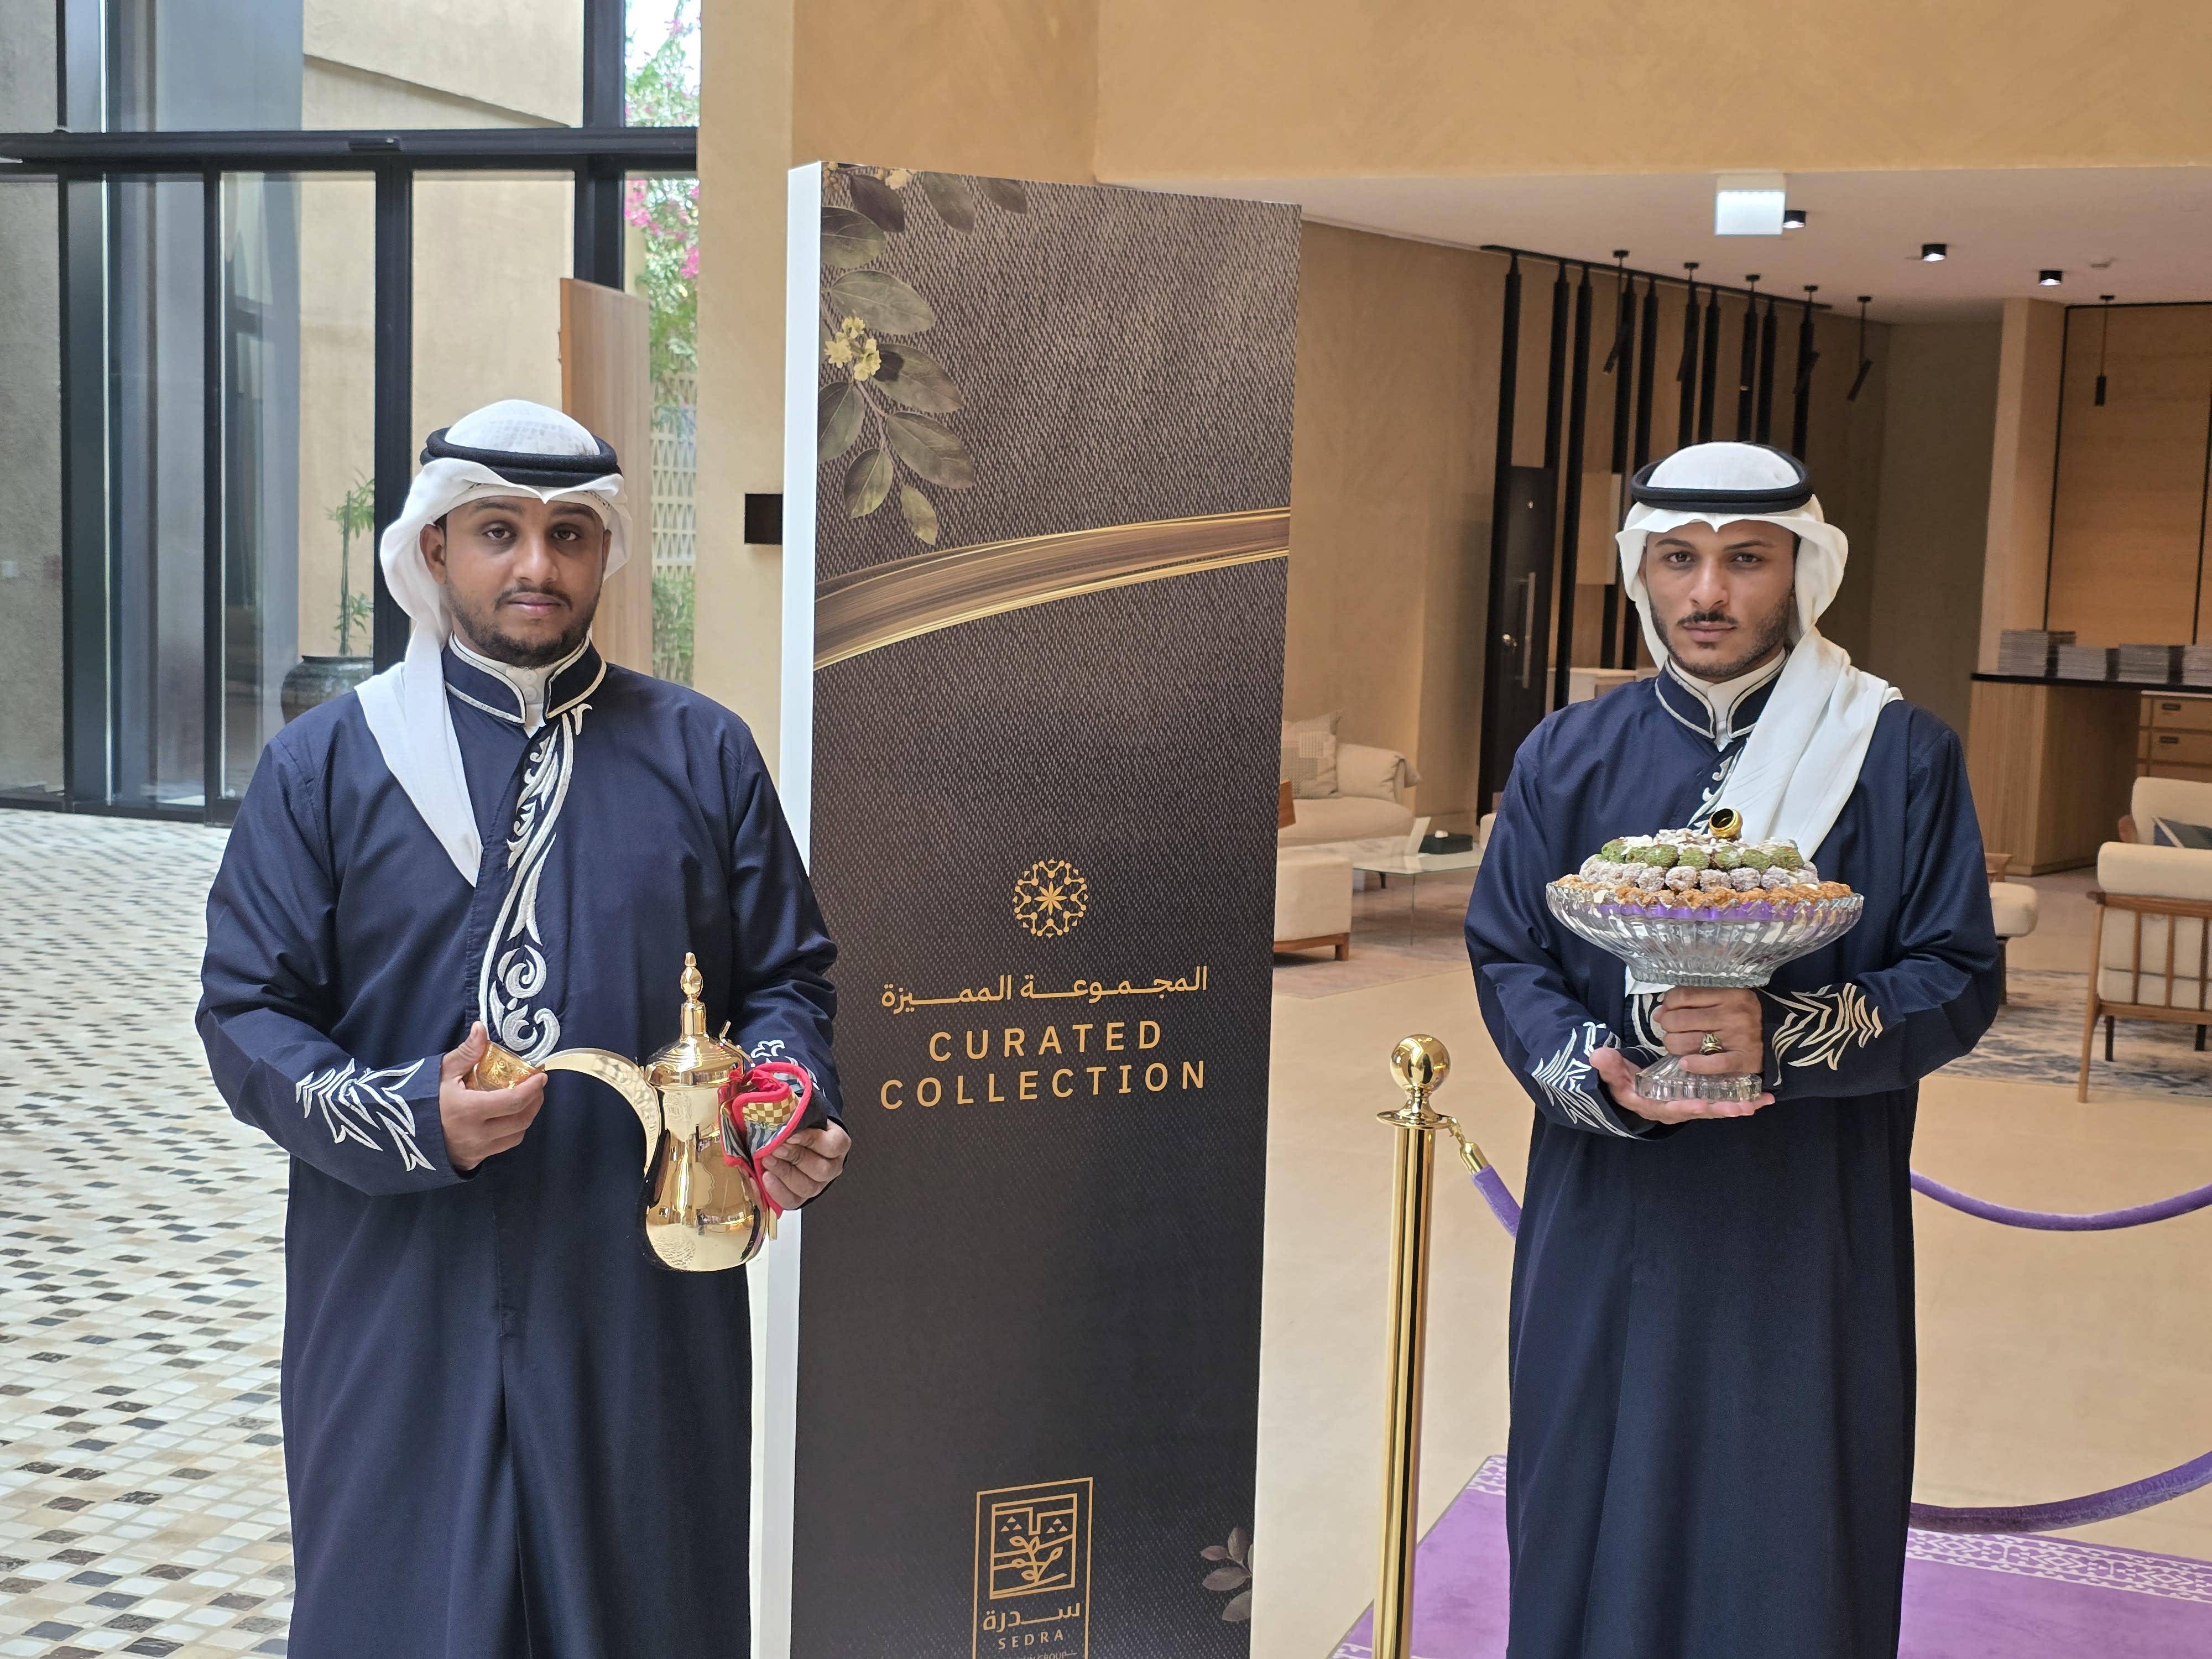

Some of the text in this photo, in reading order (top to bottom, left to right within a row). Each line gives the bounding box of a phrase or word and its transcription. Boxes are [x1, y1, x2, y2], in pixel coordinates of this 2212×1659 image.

[881, 966, 1208, 1014] المجموعة المميزة
[929, 1020, 1161, 1062] CURATED
[880, 1061, 1204, 1110] COLLECTION
[983, 1603, 1081, 1632] سدرة
[998, 1629, 1063, 1650] SEDRA
